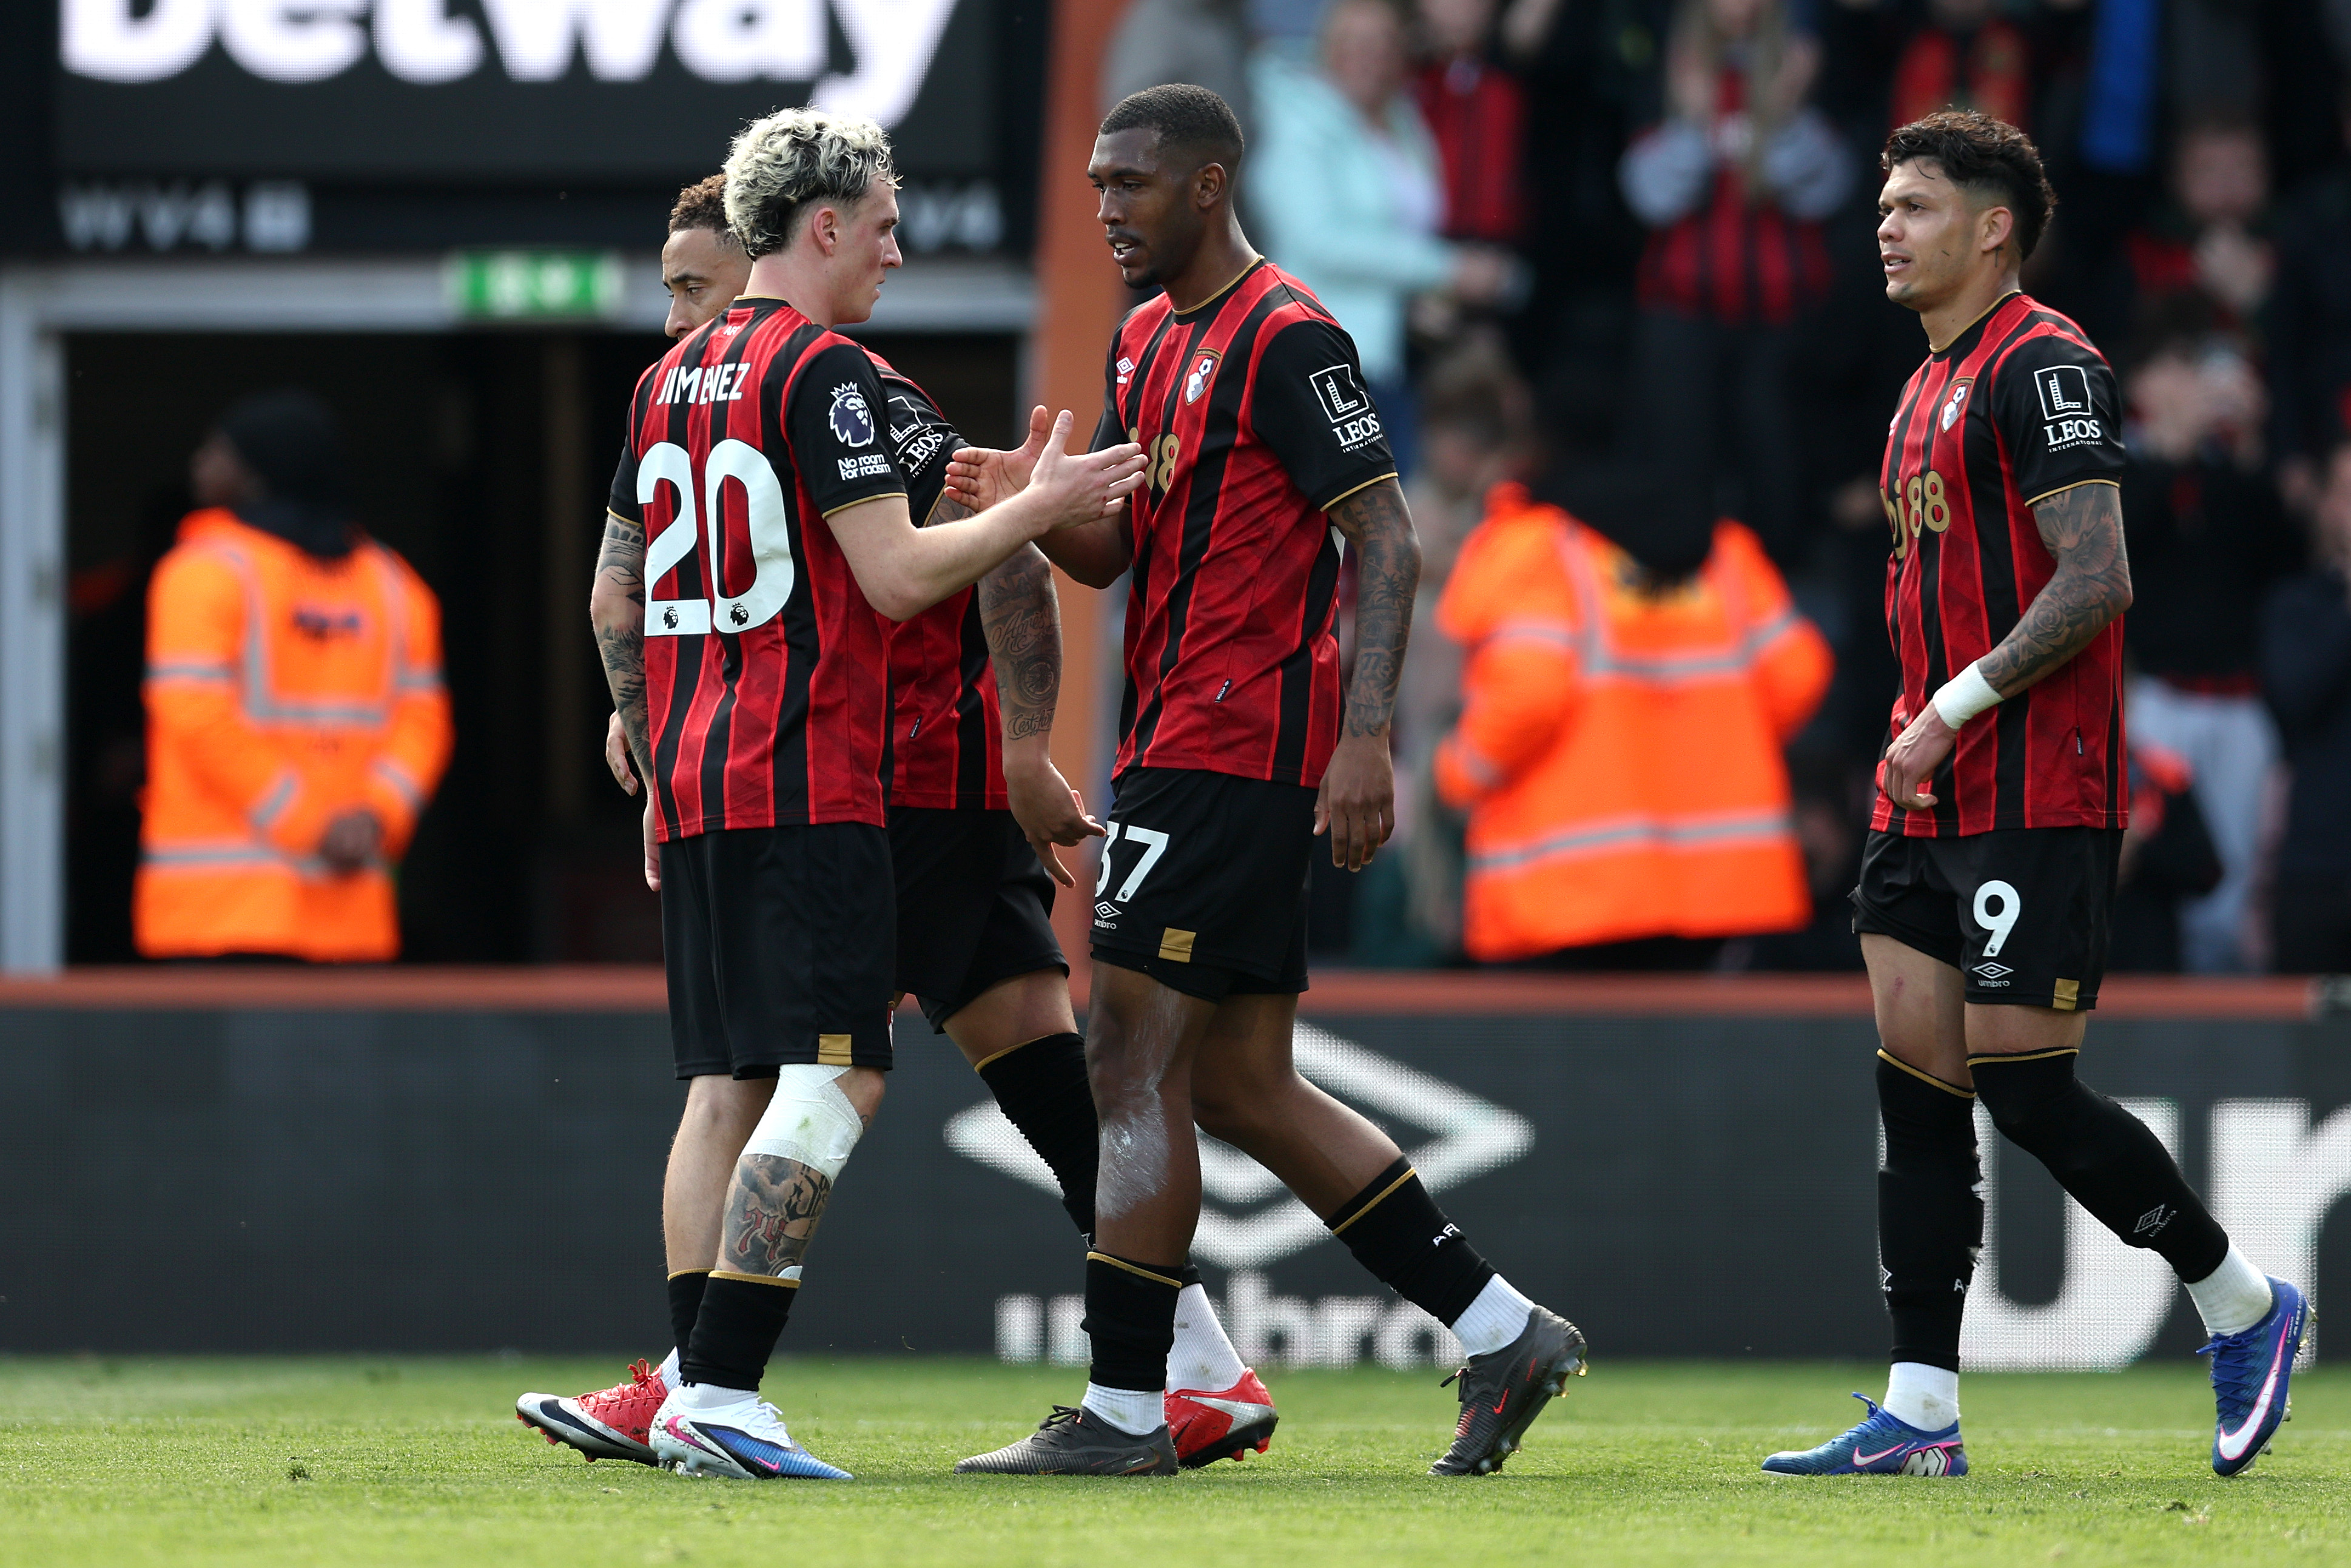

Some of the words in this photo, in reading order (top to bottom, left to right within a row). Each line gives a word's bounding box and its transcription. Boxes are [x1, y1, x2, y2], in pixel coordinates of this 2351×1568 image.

[656, 363, 751, 405] JIMENEZ
[1332, 413, 1380, 446] LEOS
[1342, 433, 1384, 453] INTERNATIONAL
[2043, 419, 2102, 446] LEOS
[898, 428, 943, 473] LEOS
[2048, 440, 2103, 453] INTERNATIONAL
[838, 457, 857, 471] No
[858, 454, 885, 466] room
[841, 468, 858, 480] for
[636, 439, 794, 636] 20
[1973, 880, 2020, 957] 9
[1978, 979, 2010, 988] umbro
[995, 1271, 1463, 1370] ubro
